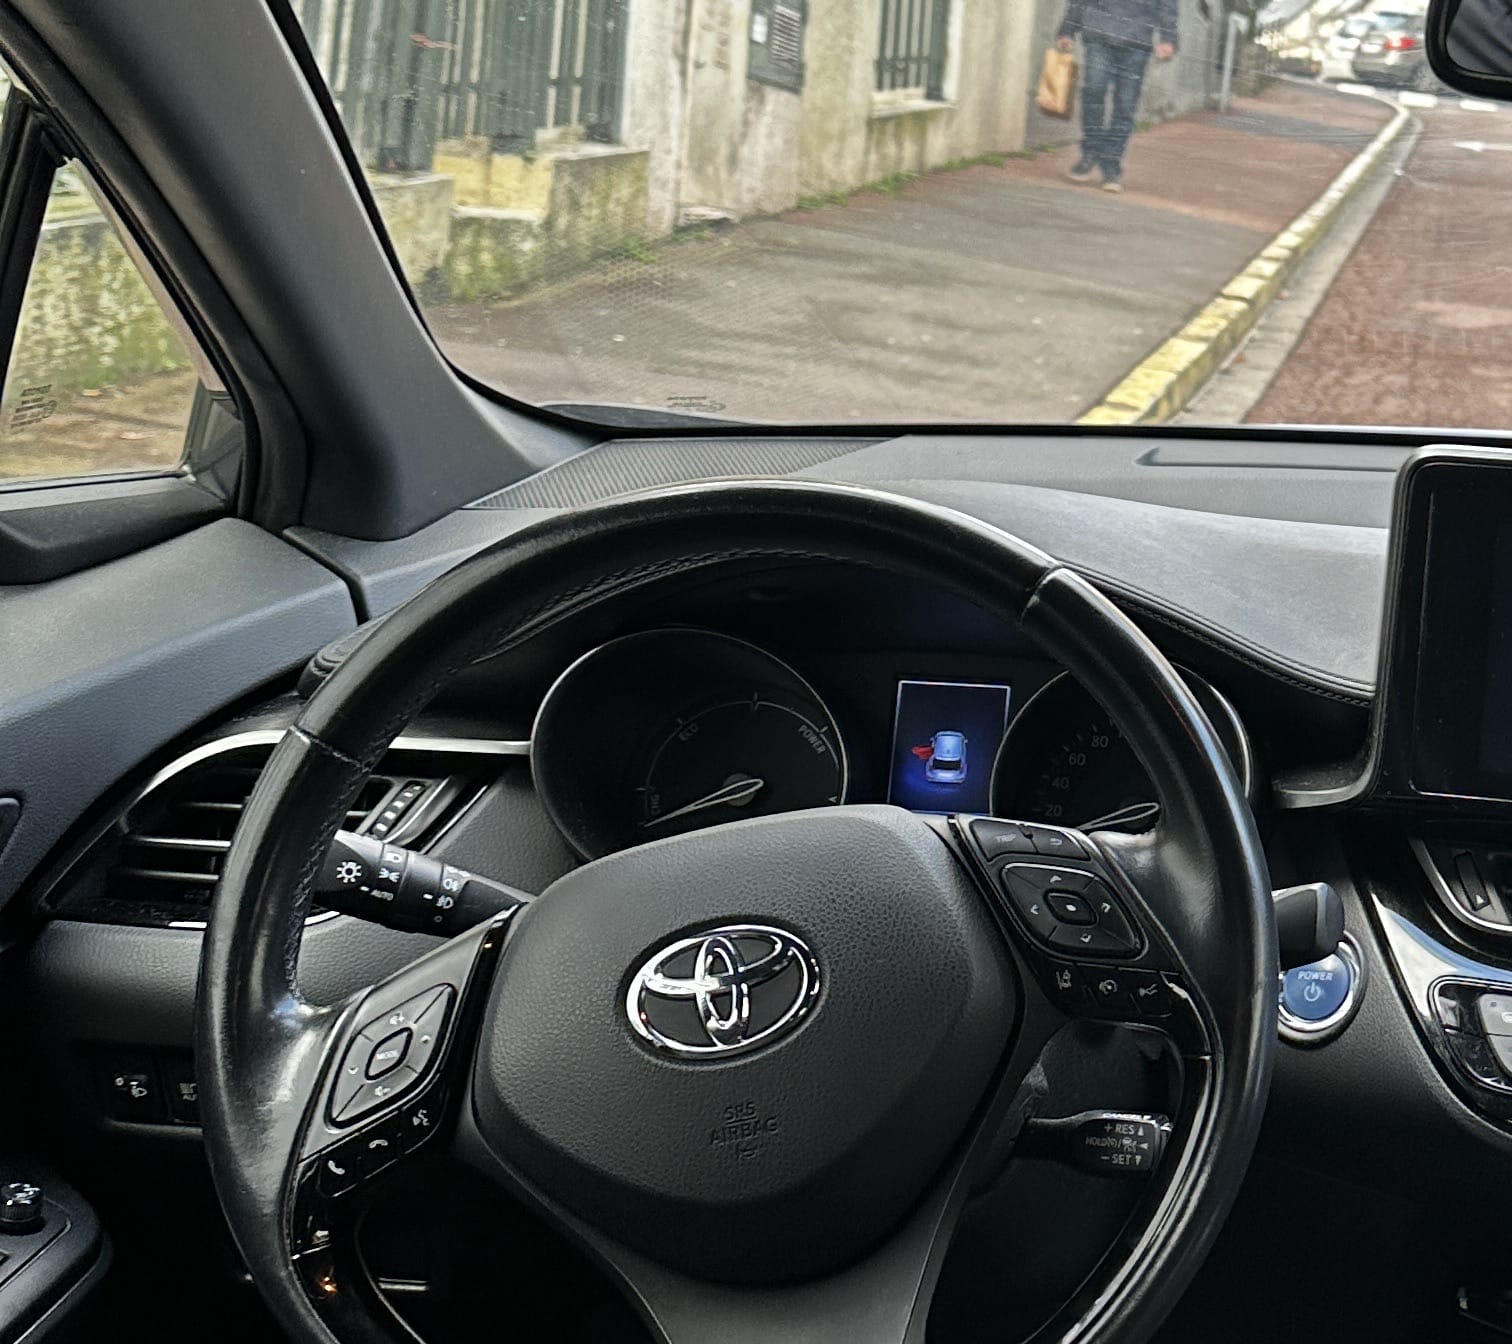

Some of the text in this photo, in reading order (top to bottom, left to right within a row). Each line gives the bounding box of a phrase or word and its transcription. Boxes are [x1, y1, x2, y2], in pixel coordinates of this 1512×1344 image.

[678, 722, 699, 742] ECO
[797, 723, 827, 755] POWER
[1091, 735, 1109, 749] 80
[1068, 753, 1087, 767] 60
[1051, 776, 1070, 790] 40
[1044, 805, 1062, 817] 20
[1298, 970, 1334, 981] POWER
[711, 1117, 778, 1146] AIRBAG
[1115, 1123, 1135, 1135] RES
[1112, 1153, 1132, 1165] SET
